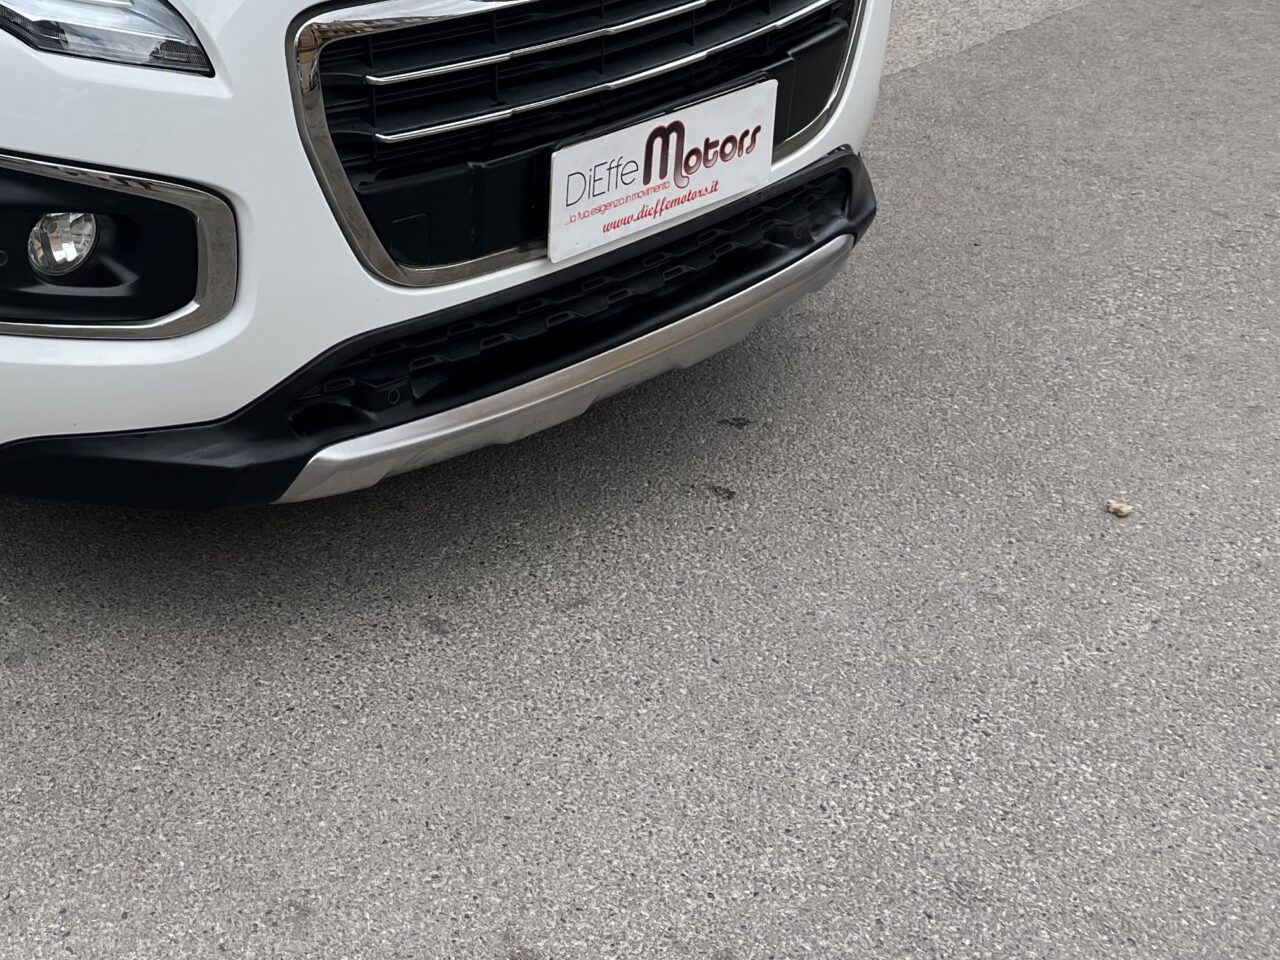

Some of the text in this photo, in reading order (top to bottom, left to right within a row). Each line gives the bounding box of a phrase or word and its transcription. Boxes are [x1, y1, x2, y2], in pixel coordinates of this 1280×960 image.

[565, 120, 762, 208] DiEffe Motors
[601, 180, 719, 234] www.dieffemotors.it
